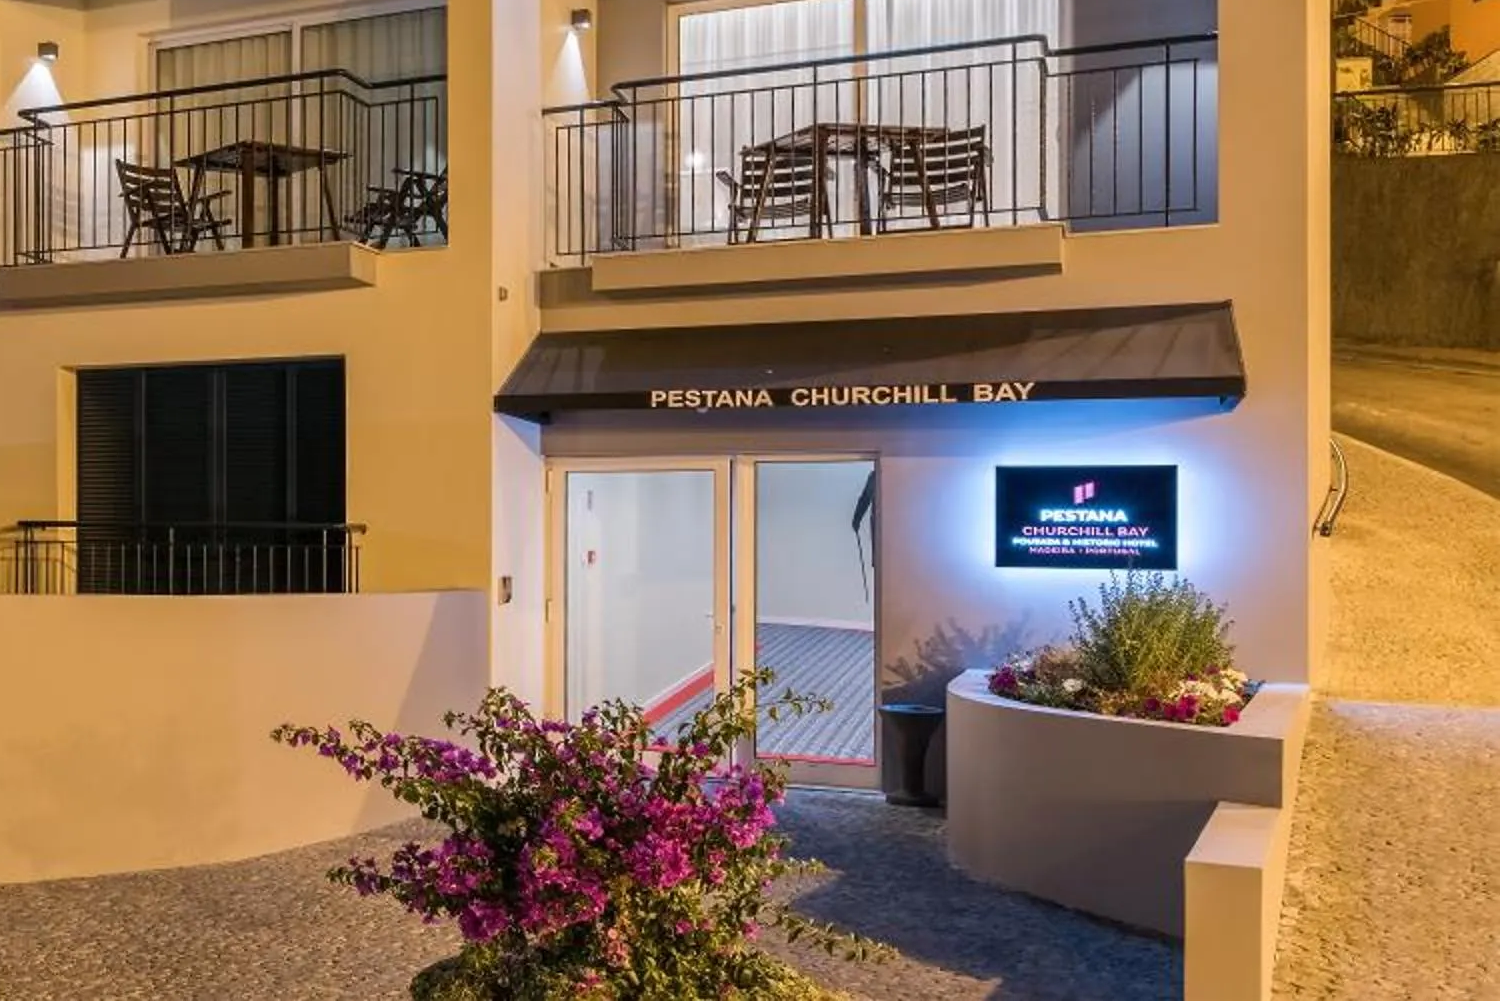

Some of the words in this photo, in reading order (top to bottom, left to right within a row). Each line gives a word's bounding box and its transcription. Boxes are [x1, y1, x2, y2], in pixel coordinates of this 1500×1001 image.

[651, 389, 773, 408] PESTANA
[791, 385, 957, 407] CHURCHILL
[973, 381, 1035, 403] BAY
[1040, 509, 1128, 522] PESTANA
[1022, 526, 1114, 536] CHURCHILL
[1117, 526, 1149, 537] BAY
